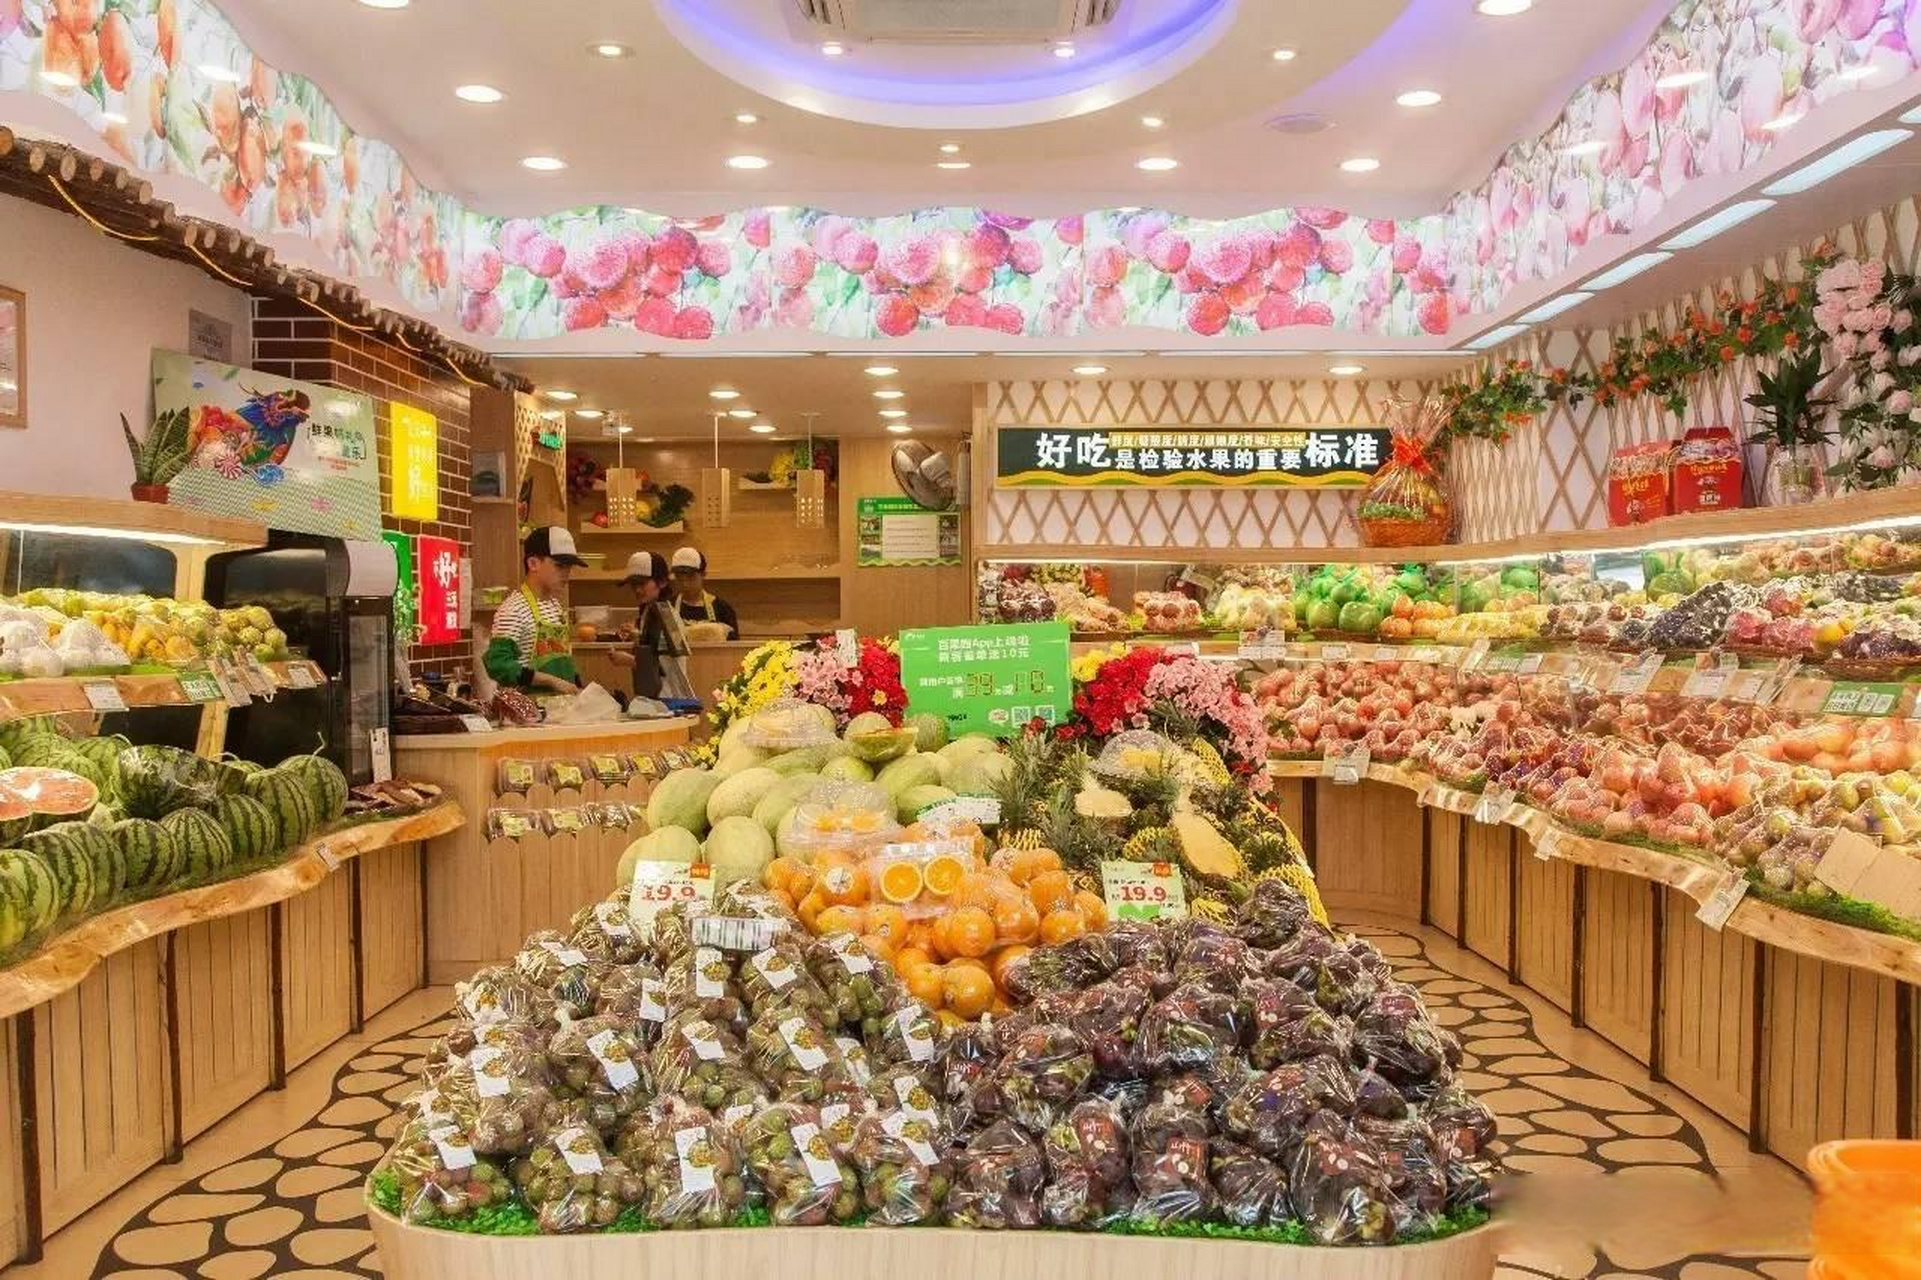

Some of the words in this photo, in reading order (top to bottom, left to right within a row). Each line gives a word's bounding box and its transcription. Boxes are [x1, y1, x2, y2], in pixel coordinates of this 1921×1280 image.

[1036, 432, 1110, 467] 好吃
[1114, 448, 1302, 470] 是检验水果的重要
[1304, 432, 1379, 468] 标准
[1121, 885, 1167, 902] 19.9
